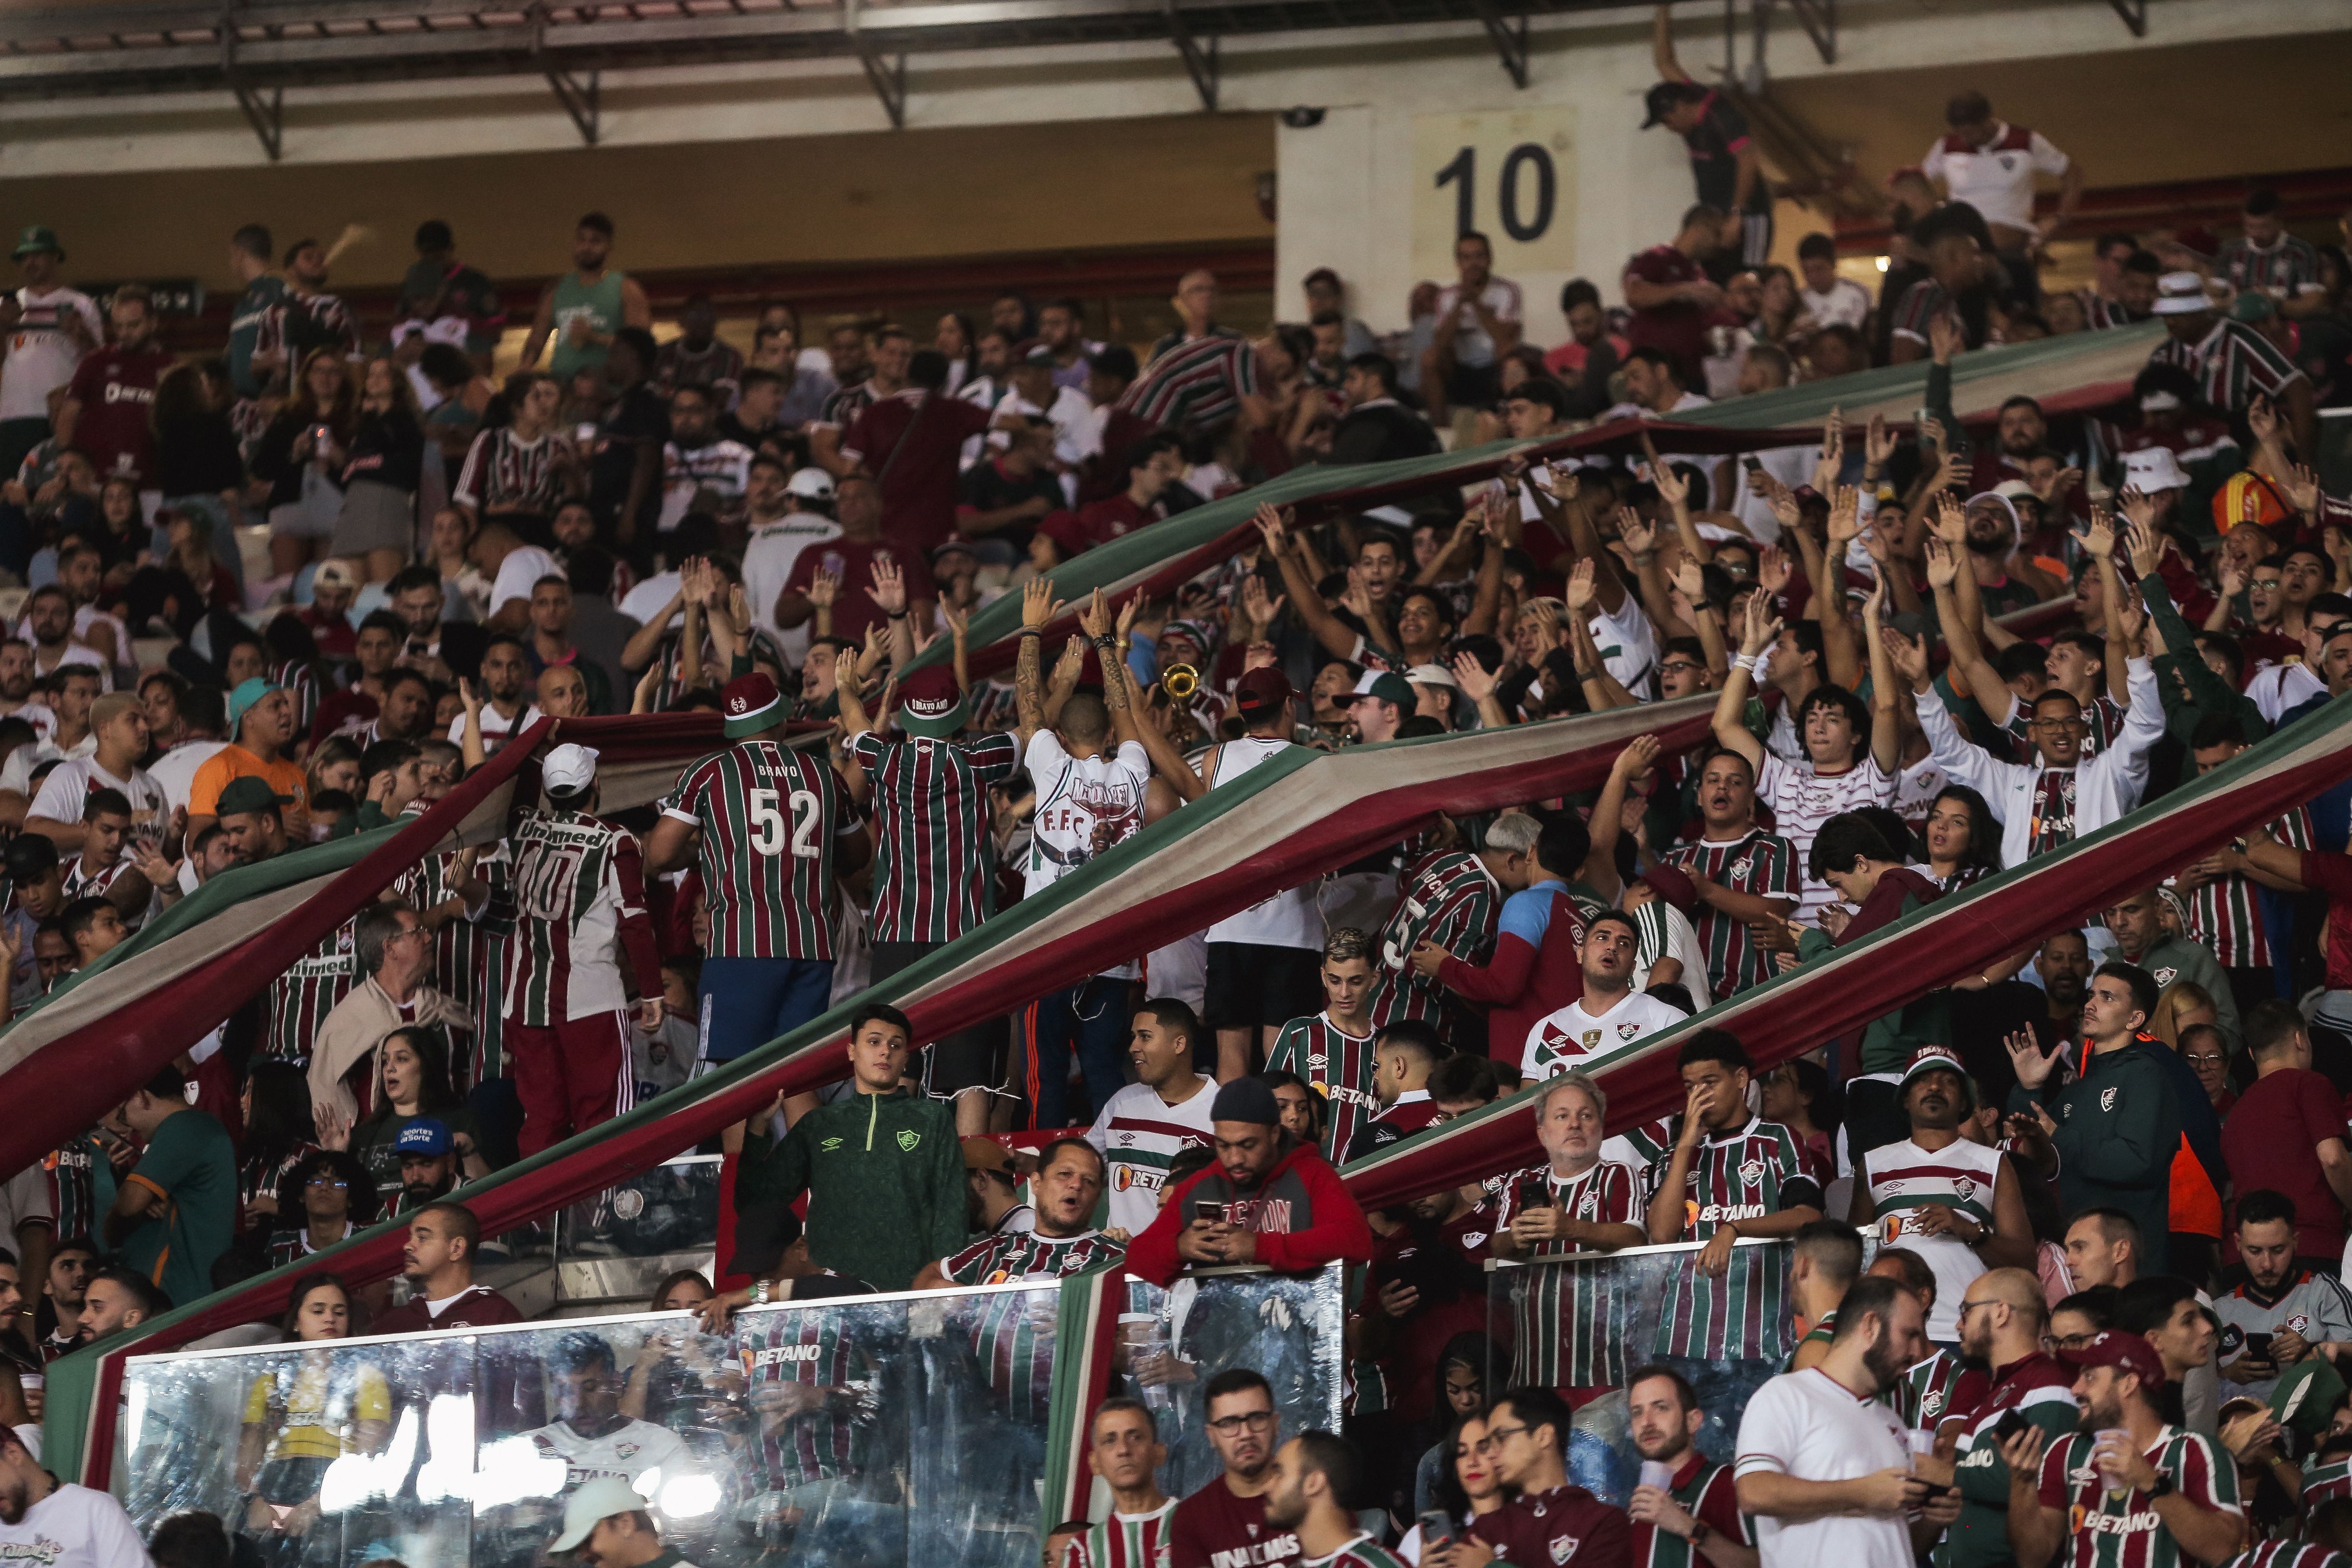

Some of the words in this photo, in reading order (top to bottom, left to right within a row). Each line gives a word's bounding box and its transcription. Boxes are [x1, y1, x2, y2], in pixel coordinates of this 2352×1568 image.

[1434, 142, 1557, 242] 10
[758, 765, 797, 777] BRAVO
[750, 788, 820, 859] 52
[517, 846, 581, 921] 10
[287, 957, 352, 975] nimed
[1329, 1085, 1381, 1113] BETANO
[1132, 1170, 1167, 1191] BETA
[1699, 1204, 1766, 1222] BETANO
[755, 1344, 822, 1367] BETANO
[2083, 1509, 2161, 1534] BETANO
